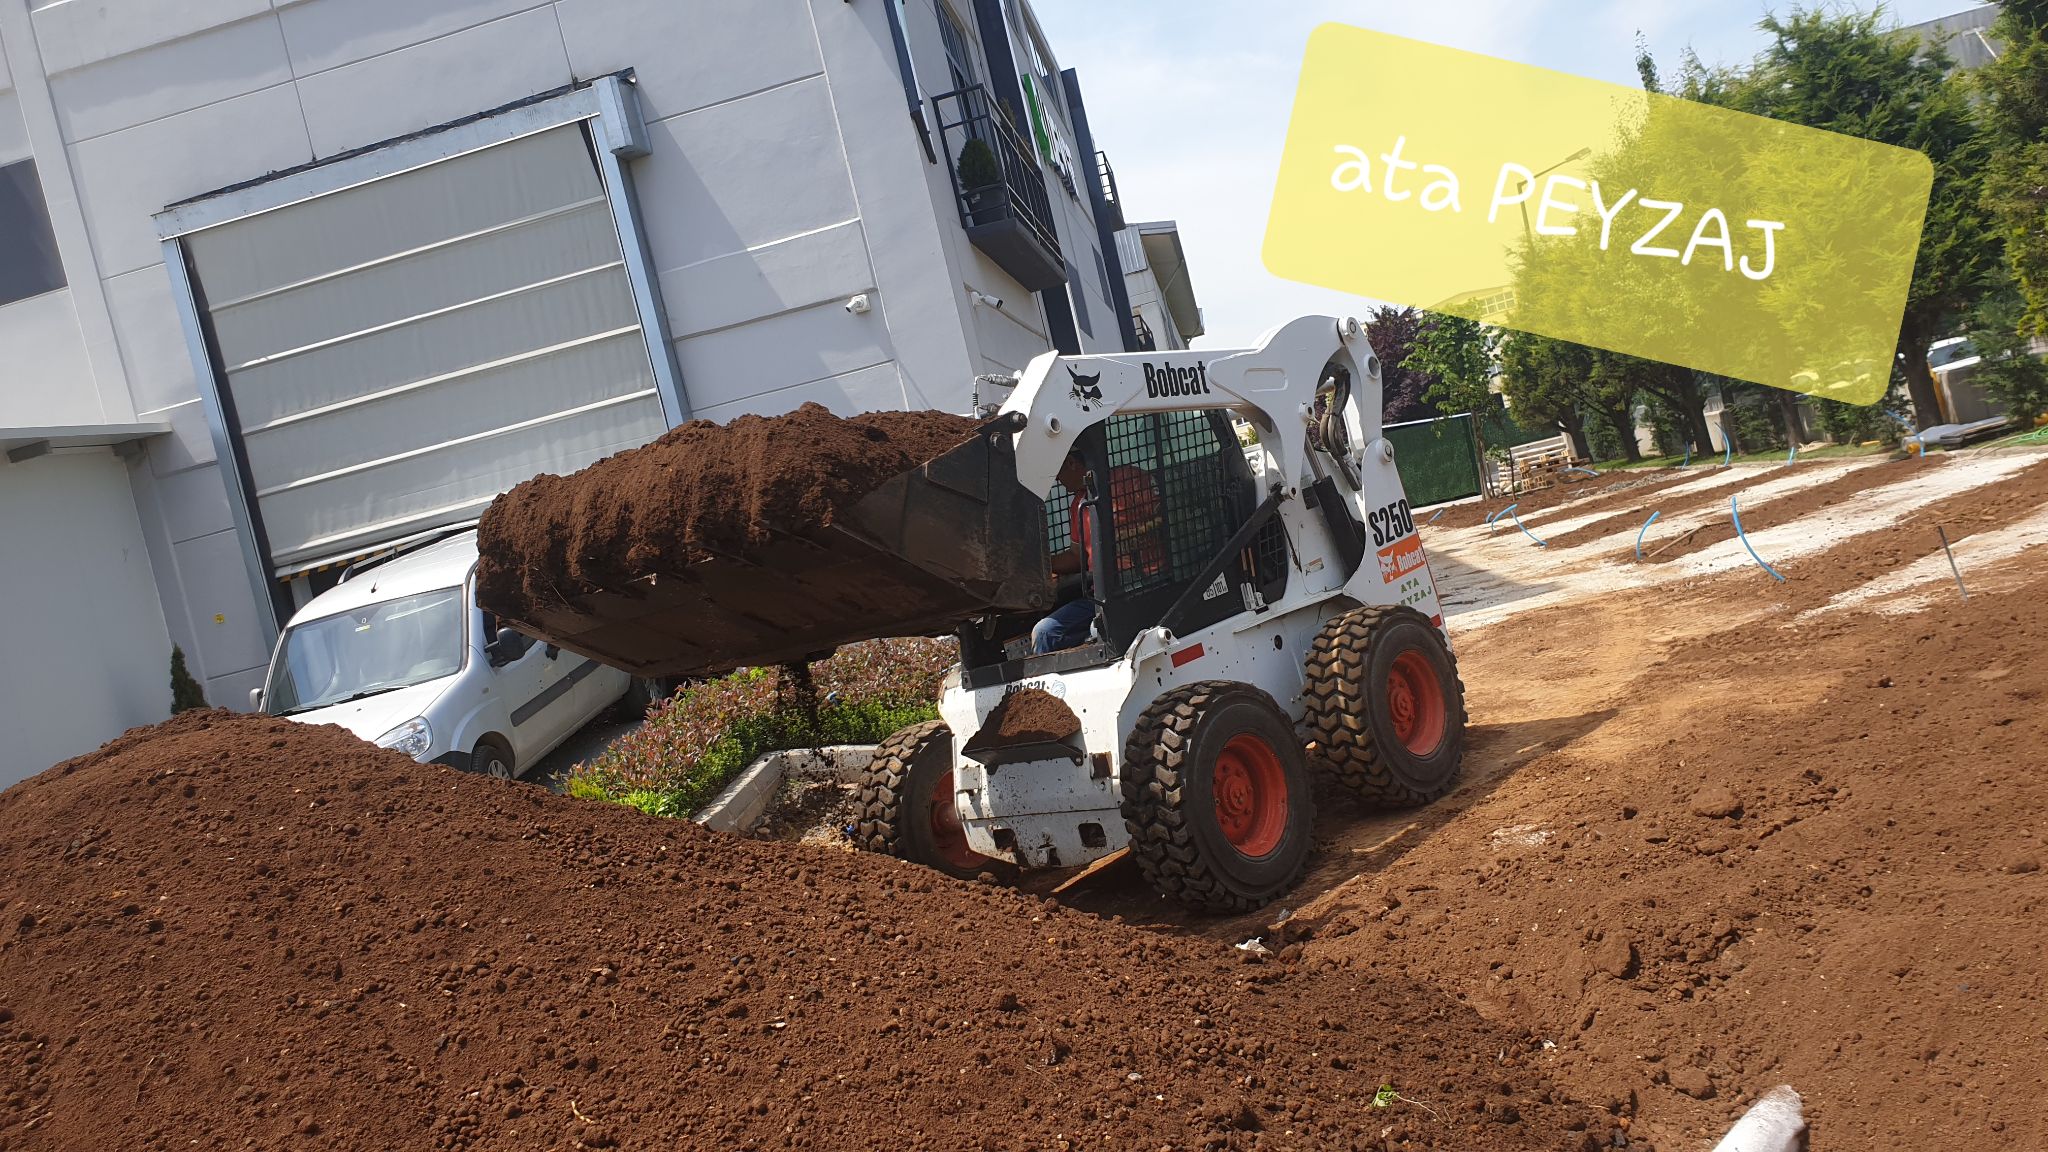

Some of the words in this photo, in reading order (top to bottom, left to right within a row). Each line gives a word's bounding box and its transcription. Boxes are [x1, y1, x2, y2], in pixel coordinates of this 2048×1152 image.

[1143, 361, 1210, 398] Bobcat
[1368, 499, 1414, 547] S250
[1396, 546, 1426, 571] Bobcat
[1401, 578, 1420, 593] ATA
